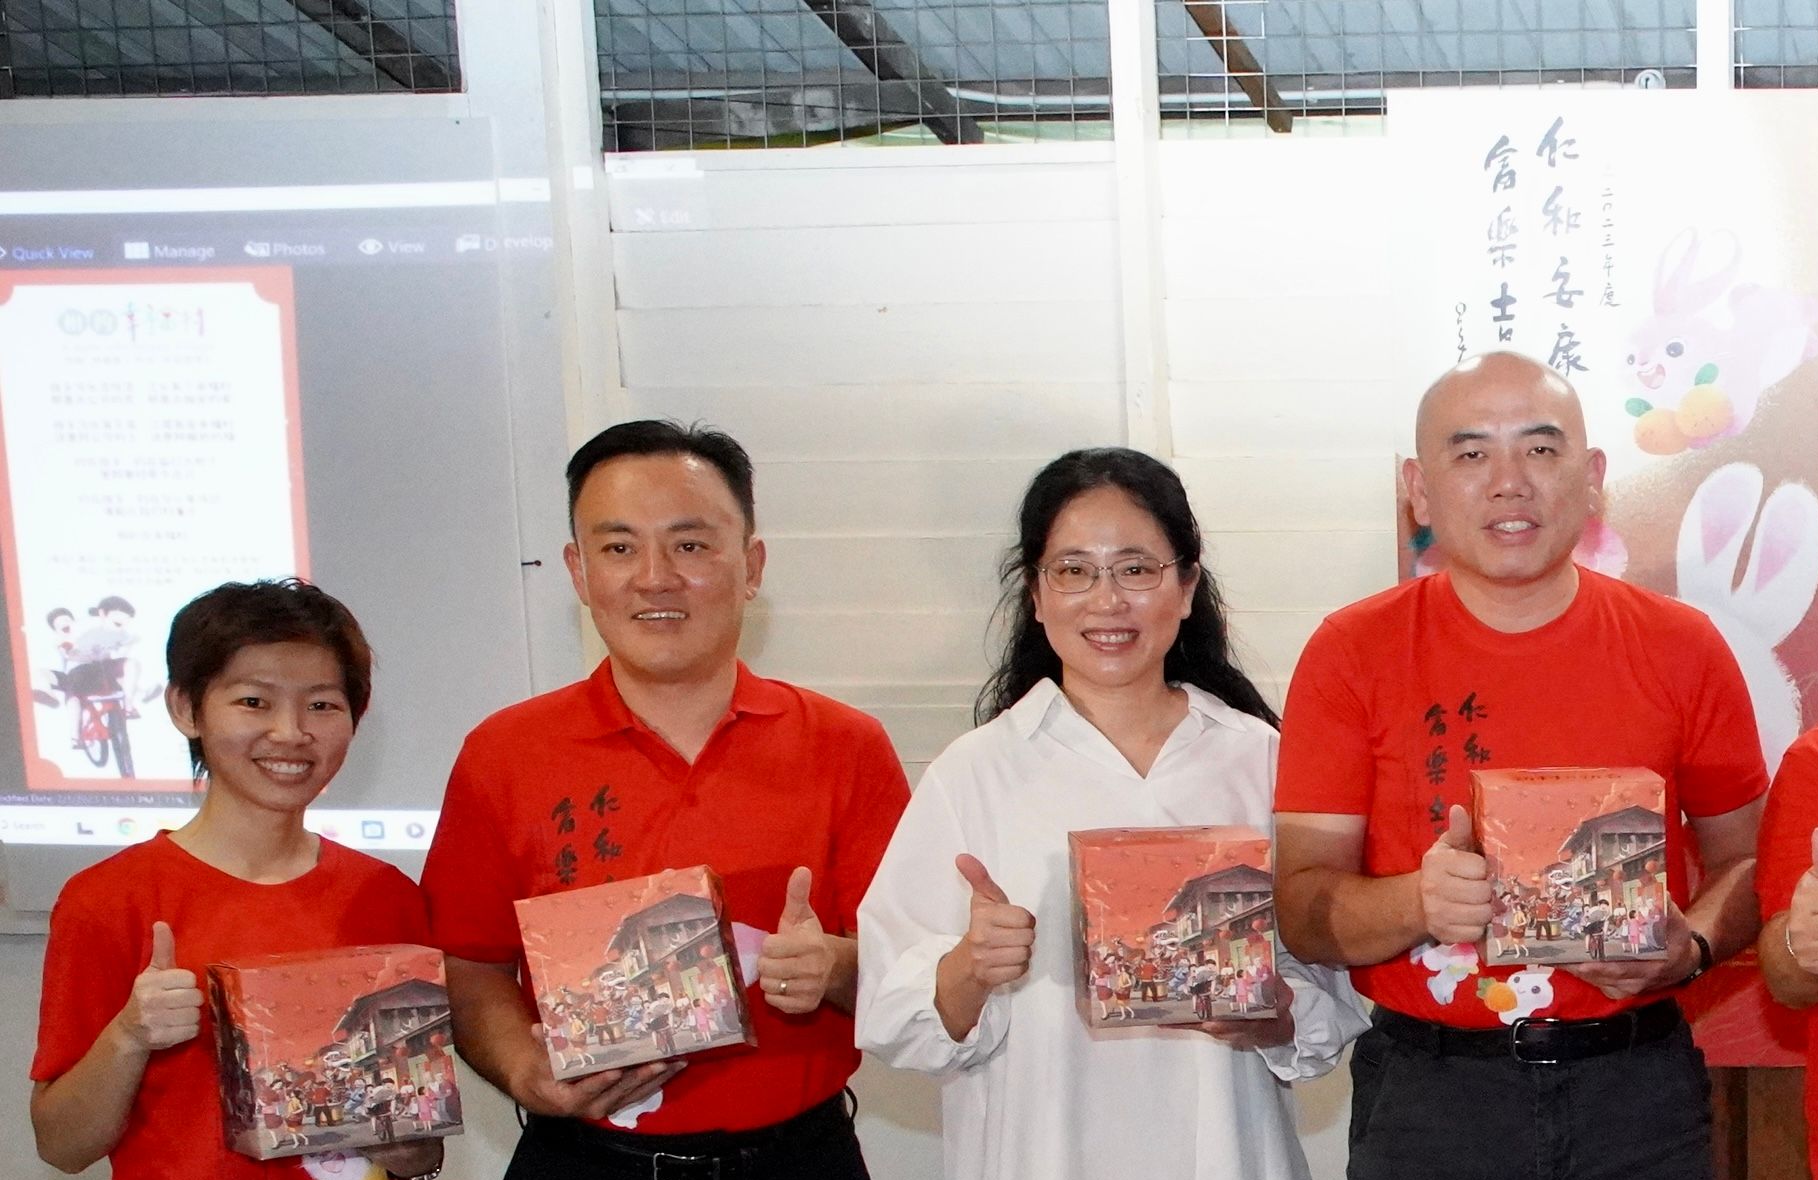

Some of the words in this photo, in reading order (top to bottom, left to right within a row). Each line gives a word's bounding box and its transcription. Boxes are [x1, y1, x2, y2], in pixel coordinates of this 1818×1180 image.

[12, 246, 54, 260] Quick
[59, 246, 95, 260] View
[154, 244, 216, 261] Manage
[273, 241, 326, 257] Photos
[388, 239, 425, 254] View
